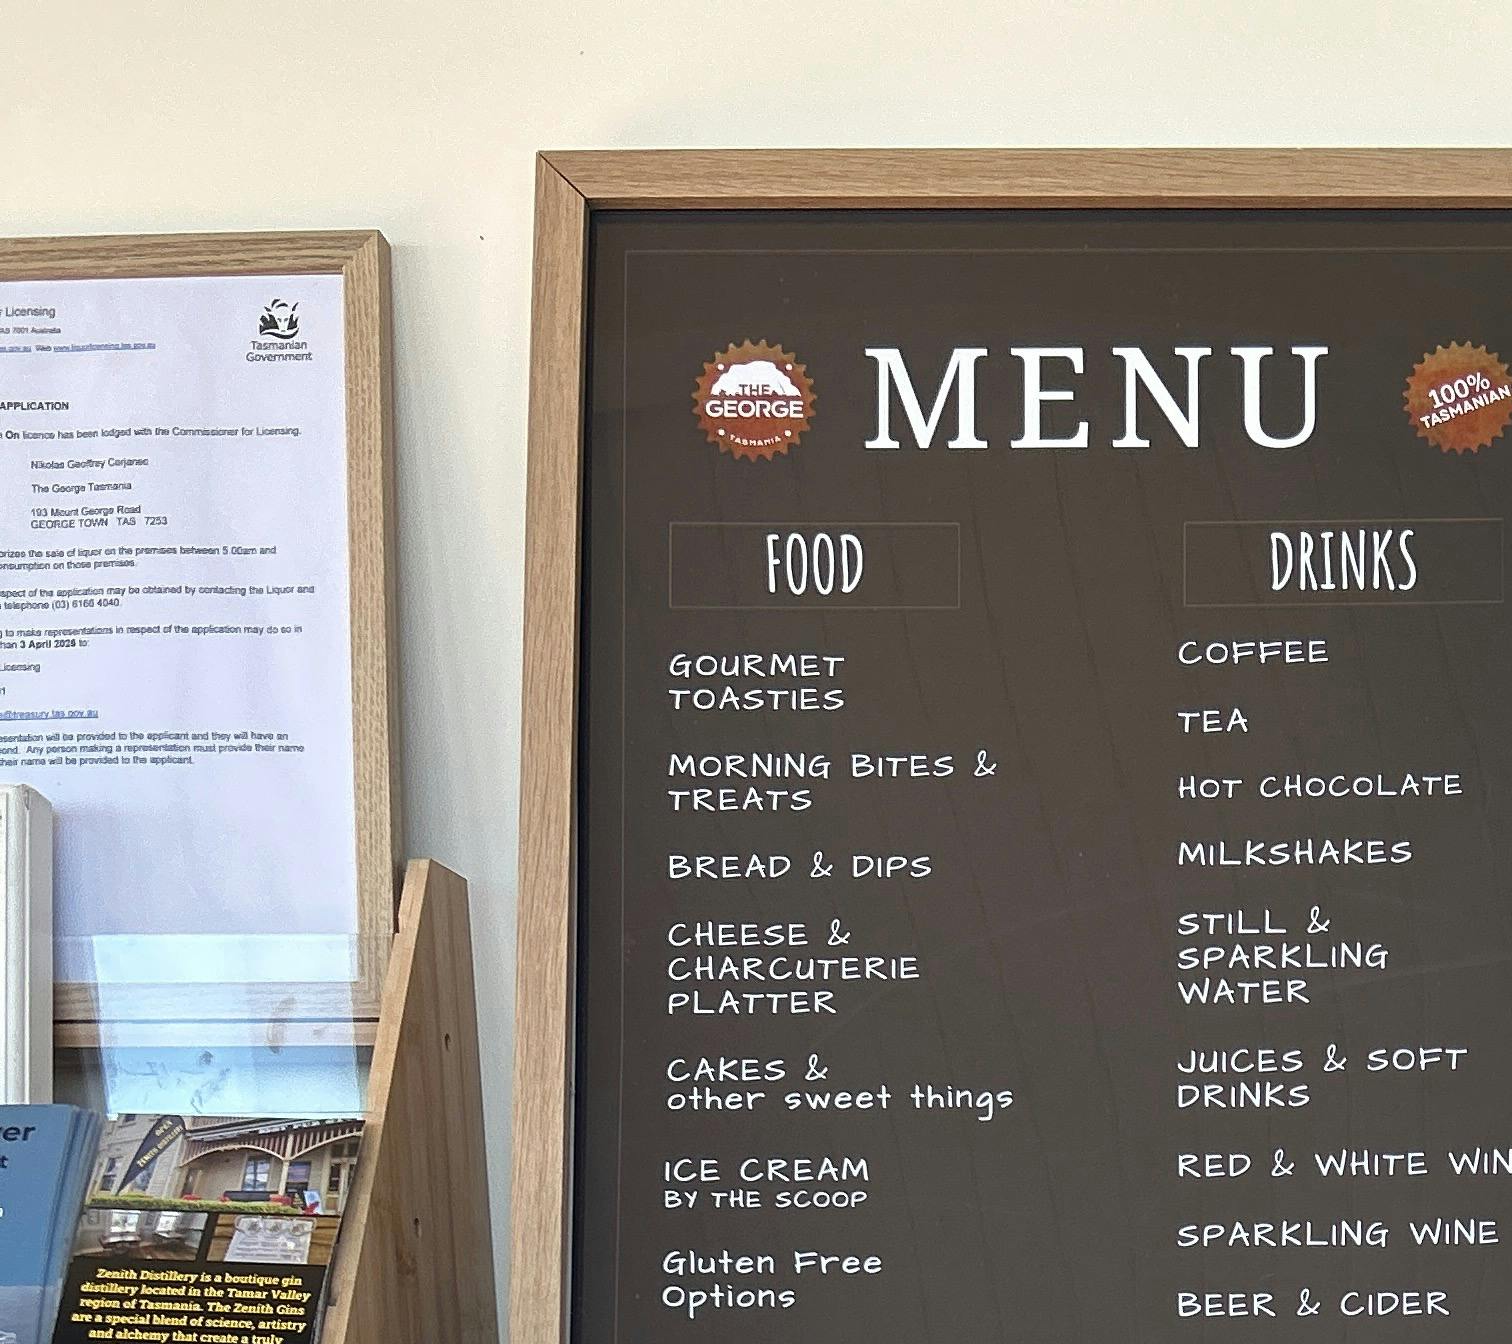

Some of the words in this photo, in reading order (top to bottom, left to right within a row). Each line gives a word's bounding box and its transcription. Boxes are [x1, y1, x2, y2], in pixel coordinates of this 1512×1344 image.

[246, 352, 312, 362] Government
[251, 341, 307, 350] Tasmanian
[739, 384, 772, 396] THE
[865, 347, 1328, 448] MENU
[1428, 372, 1490, 409] 100%
[705, 400, 804, 418] GEORGE
[1419, 385, 1512, 429] TASMANIAN
[767, 533, 862, 595] FOOD
[1271, 530, 1416, 590] DRINKS
[670, 654, 844, 677] GOURMET
[1179, 641, 1328, 664] COFFEE
[669, 687, 843, 710] TOASTIES
[1178, 708, 1247, 732] TEA
[669, 753, 830, 778] MORNING
[852, 754, 953, 777] BITES
[974, 751, 996, 776] &
[668, 787, 811, 811] TREATS
[1179, 776, 1242, 798] HOT
[1260, 774, 1462, 797] CHOCOLATE
[670, 854, 790, 878] BREAD
[811, 851, 833, 877] &
[853, 856, 931, 877] DIPS
[1179, 839, 1411, 865] MILKSHAKES
[668, 1057, 785, 1081] CAKES
[805, 1054, 827, 1080] &
[668, 1087, 765, 1109] other
[785, 1085, 891, 1109] sweet
[911, 1085, 1012, 1121] things
[665, 1159, 720, 1181] ICE
[741, 1158, 868, 1181] CREAM
[1179, 1154, 1250, 1177] RED
[1272, 1149, 1294, 1176] &
[1315, 1149, 1427, 1176] WHITE
[665, 1191, 697, 1208] BY
[711, 1189, 761, 1207] THE
[776, 1191, 867, 1207] SCOOP
[1178, 1220, 1388, 1247] SPARKLING
[1410, 1218, 1498, 1244] WINE
[663, 1250, 774, 1275] Gluten
[795, 1251, 881, 1273] Free
[663, 1284, 795, 1318] Options
[1178, 1293, 1275, 1316] BEER
[1297, 1288, 1320, 1315] &
[1341, 1292, 1449, 1315] CIDER
